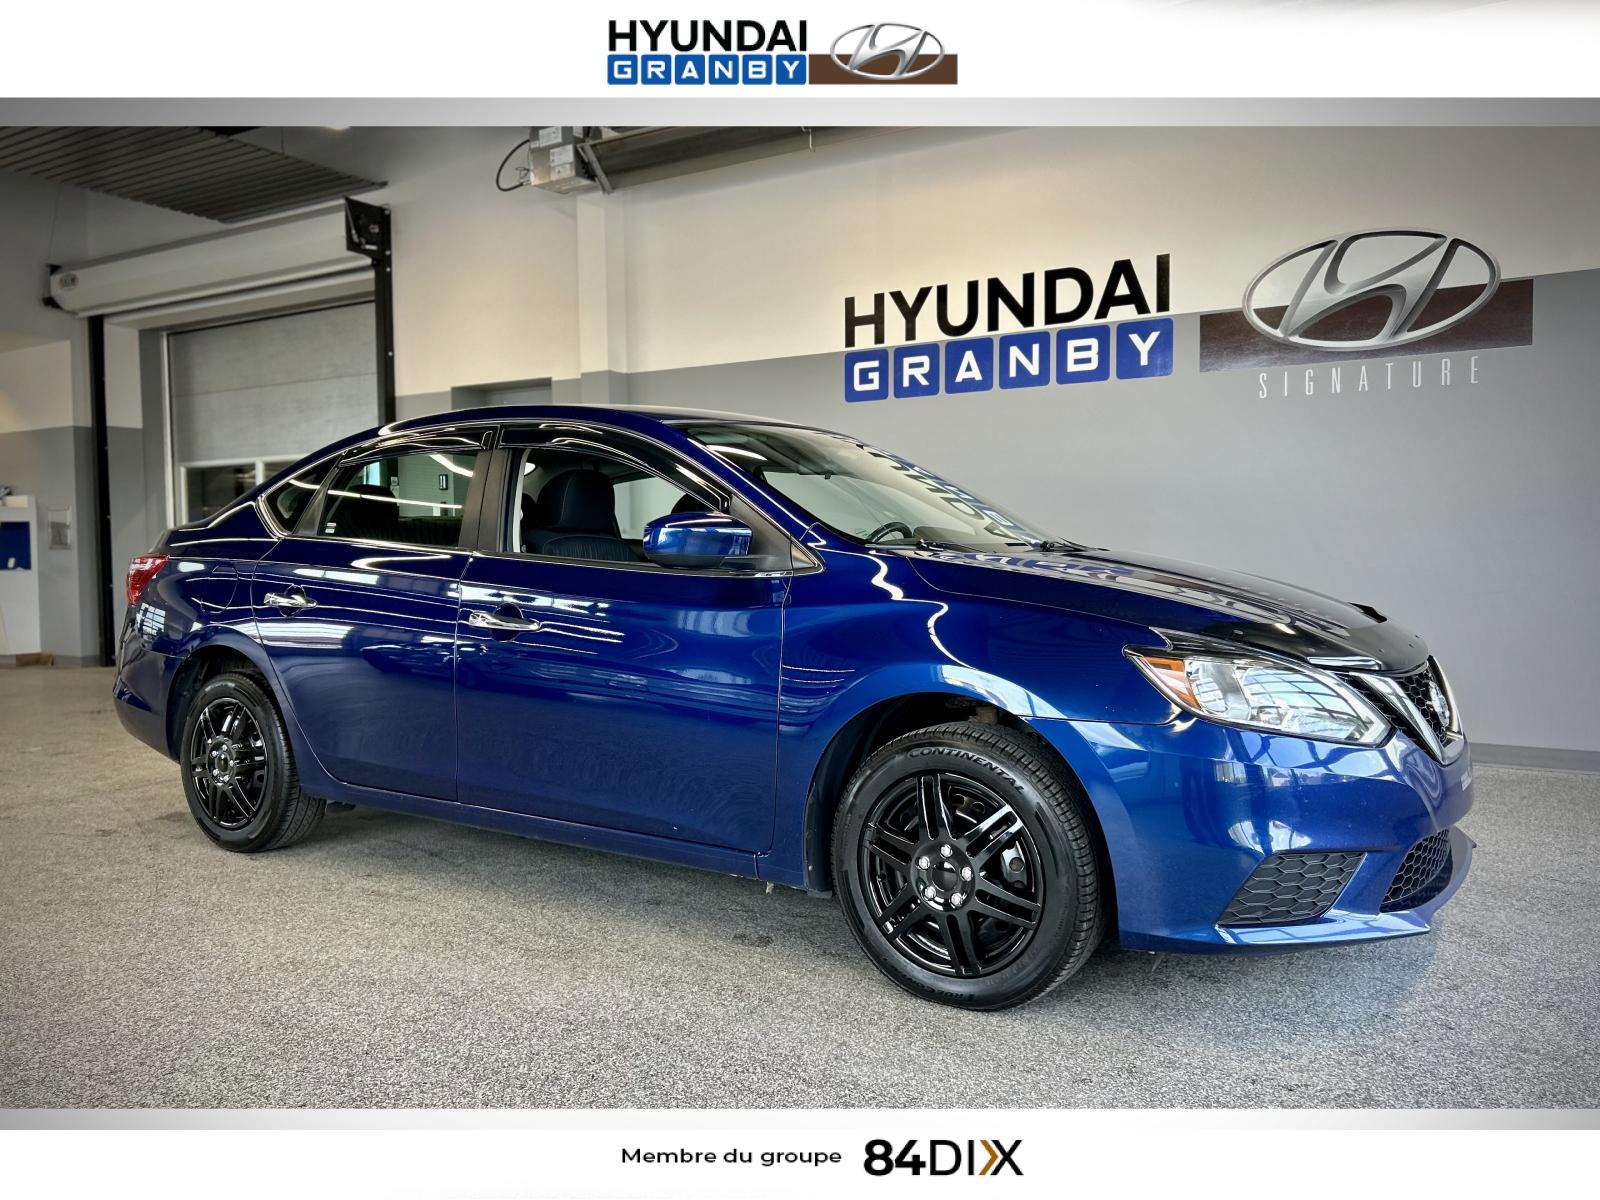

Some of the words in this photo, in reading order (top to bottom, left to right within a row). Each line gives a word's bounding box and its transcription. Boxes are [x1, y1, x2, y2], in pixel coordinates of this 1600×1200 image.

[844, 253, 1170, 349] HYUNDAI
[852, 331, 1165, 393] GRANBY
[1258, 355, 1480, 399] SIGNATURE
[907, 747, 1025, 795] CONTINENTAL
